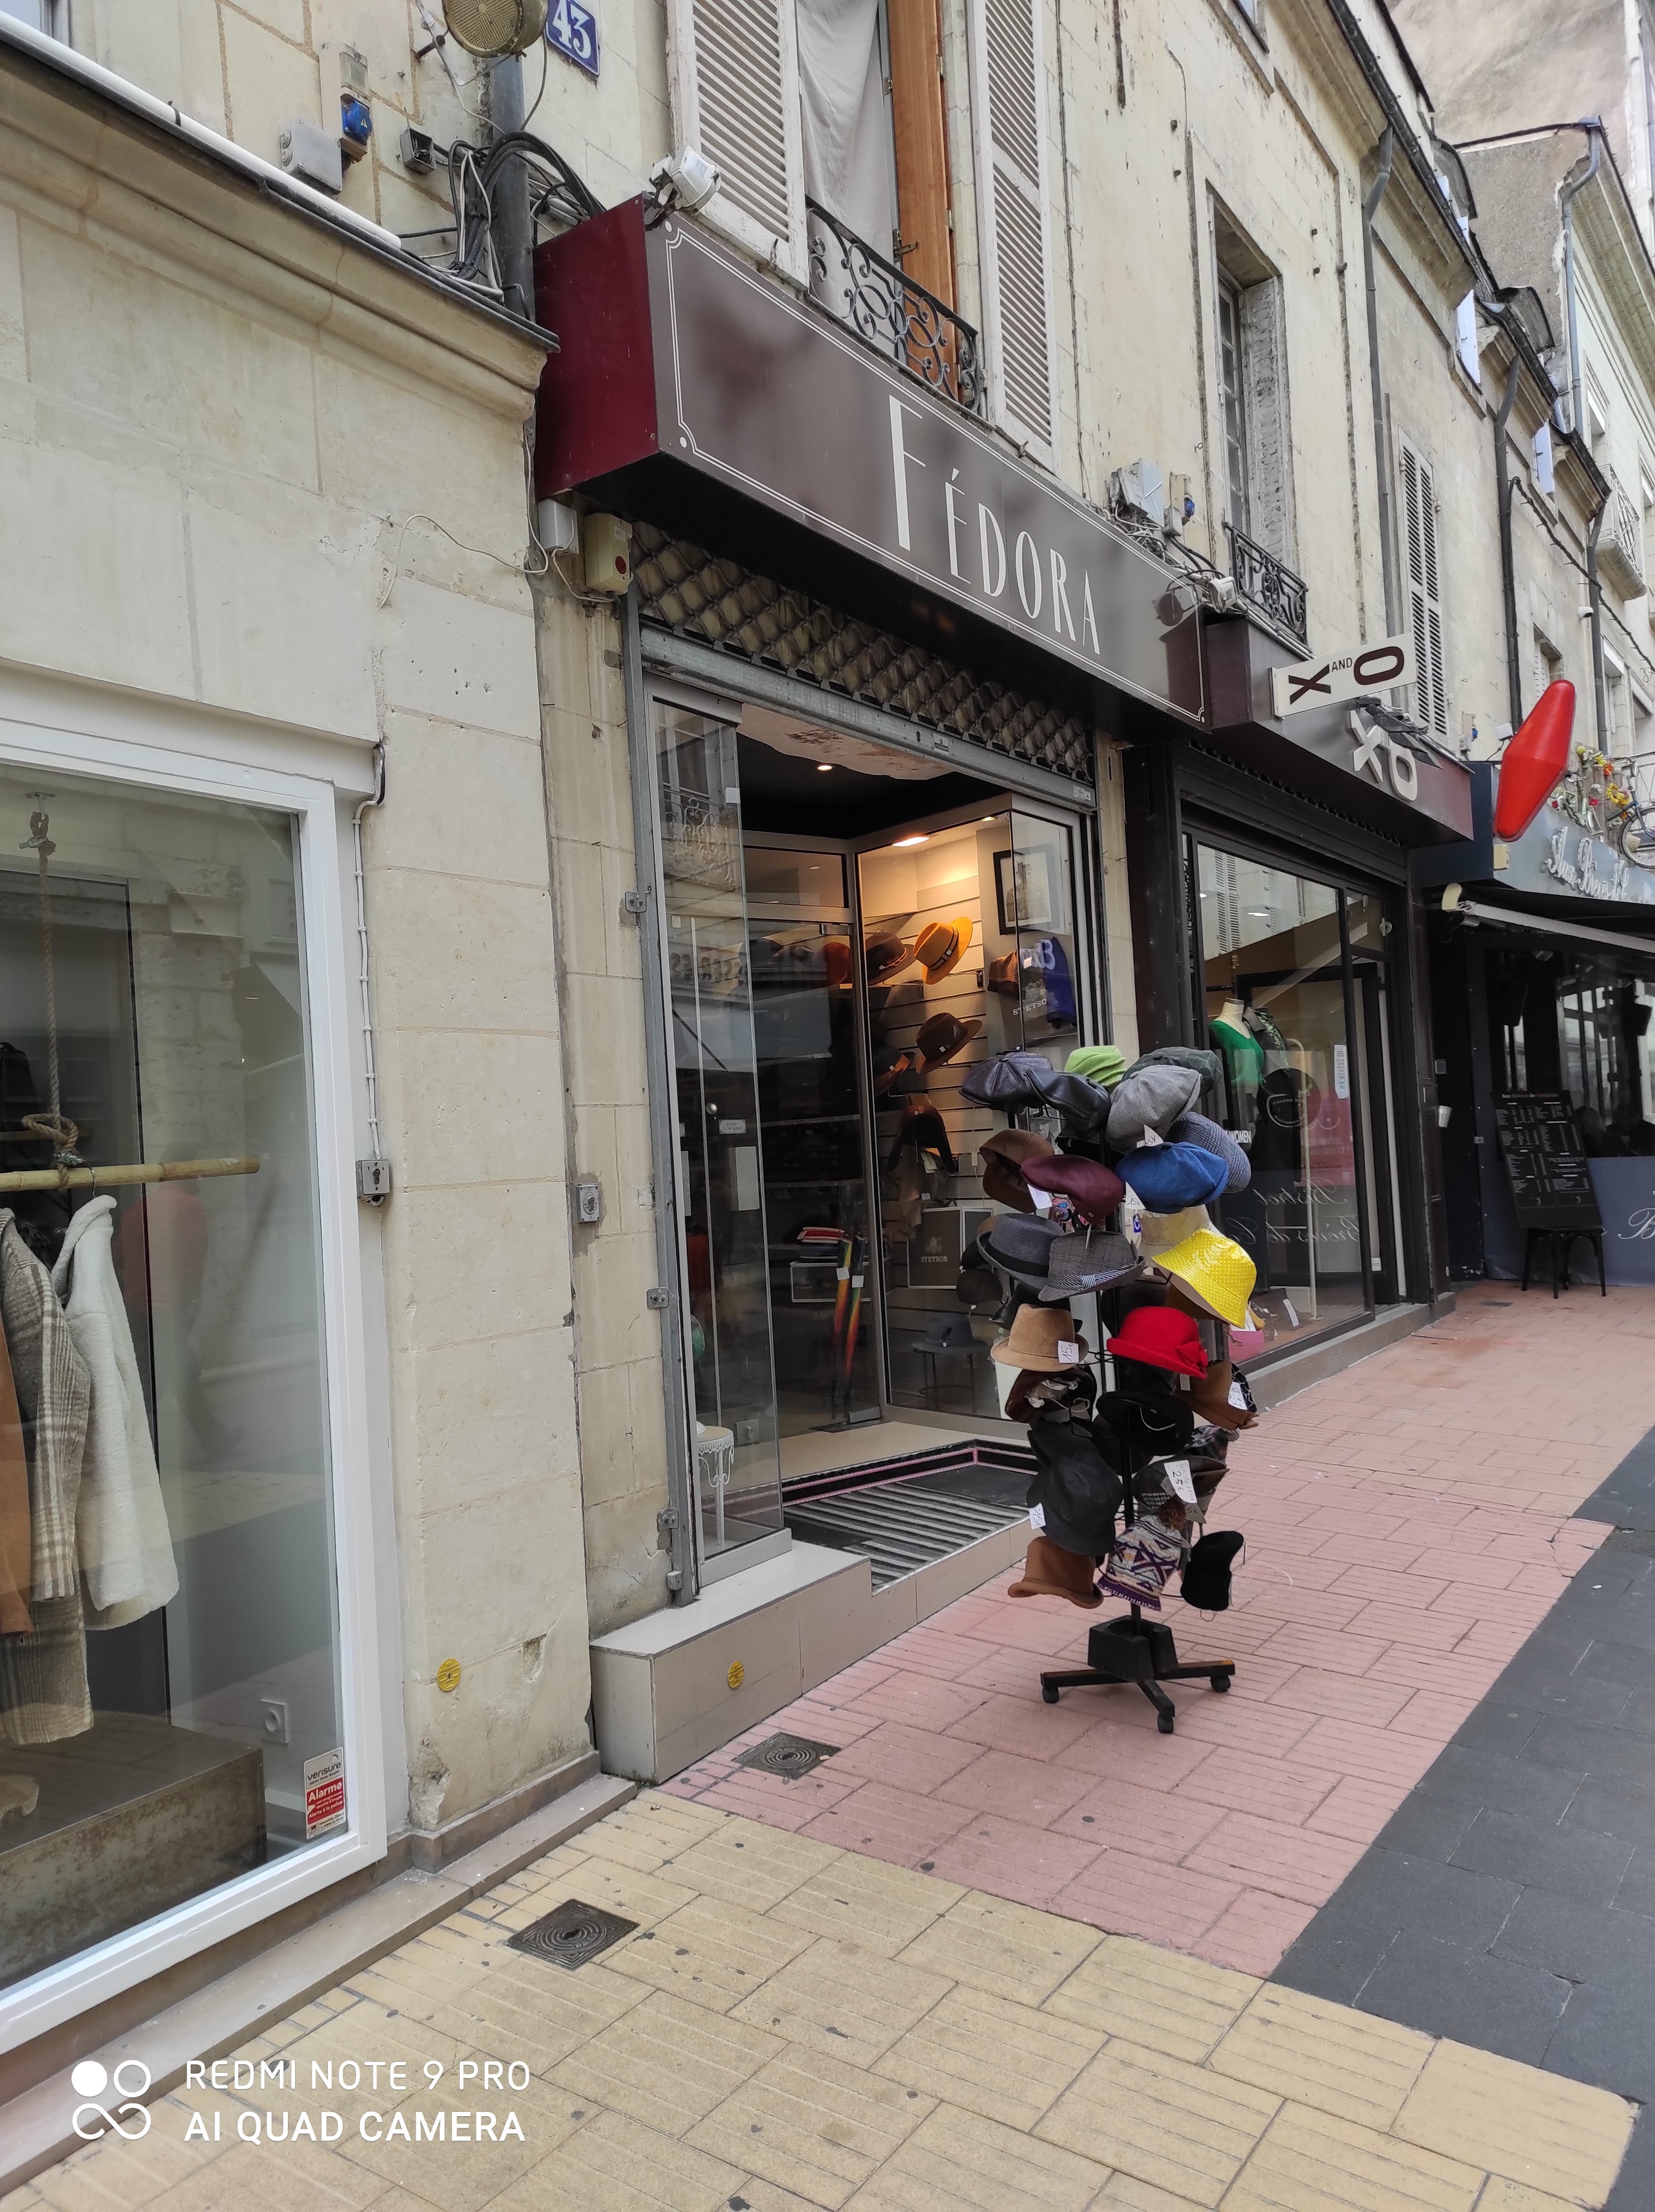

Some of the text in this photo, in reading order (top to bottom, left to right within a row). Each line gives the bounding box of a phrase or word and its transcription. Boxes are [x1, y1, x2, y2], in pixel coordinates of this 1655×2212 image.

[552, 0, 592, 59] 43
[889, 394, 1100, 655] FÉDORA
[1288, 646, 1405, 706] X AND O
[307, 1762, 341, 1781] verisure
[308, 1781, 342, 1803] Alarme
